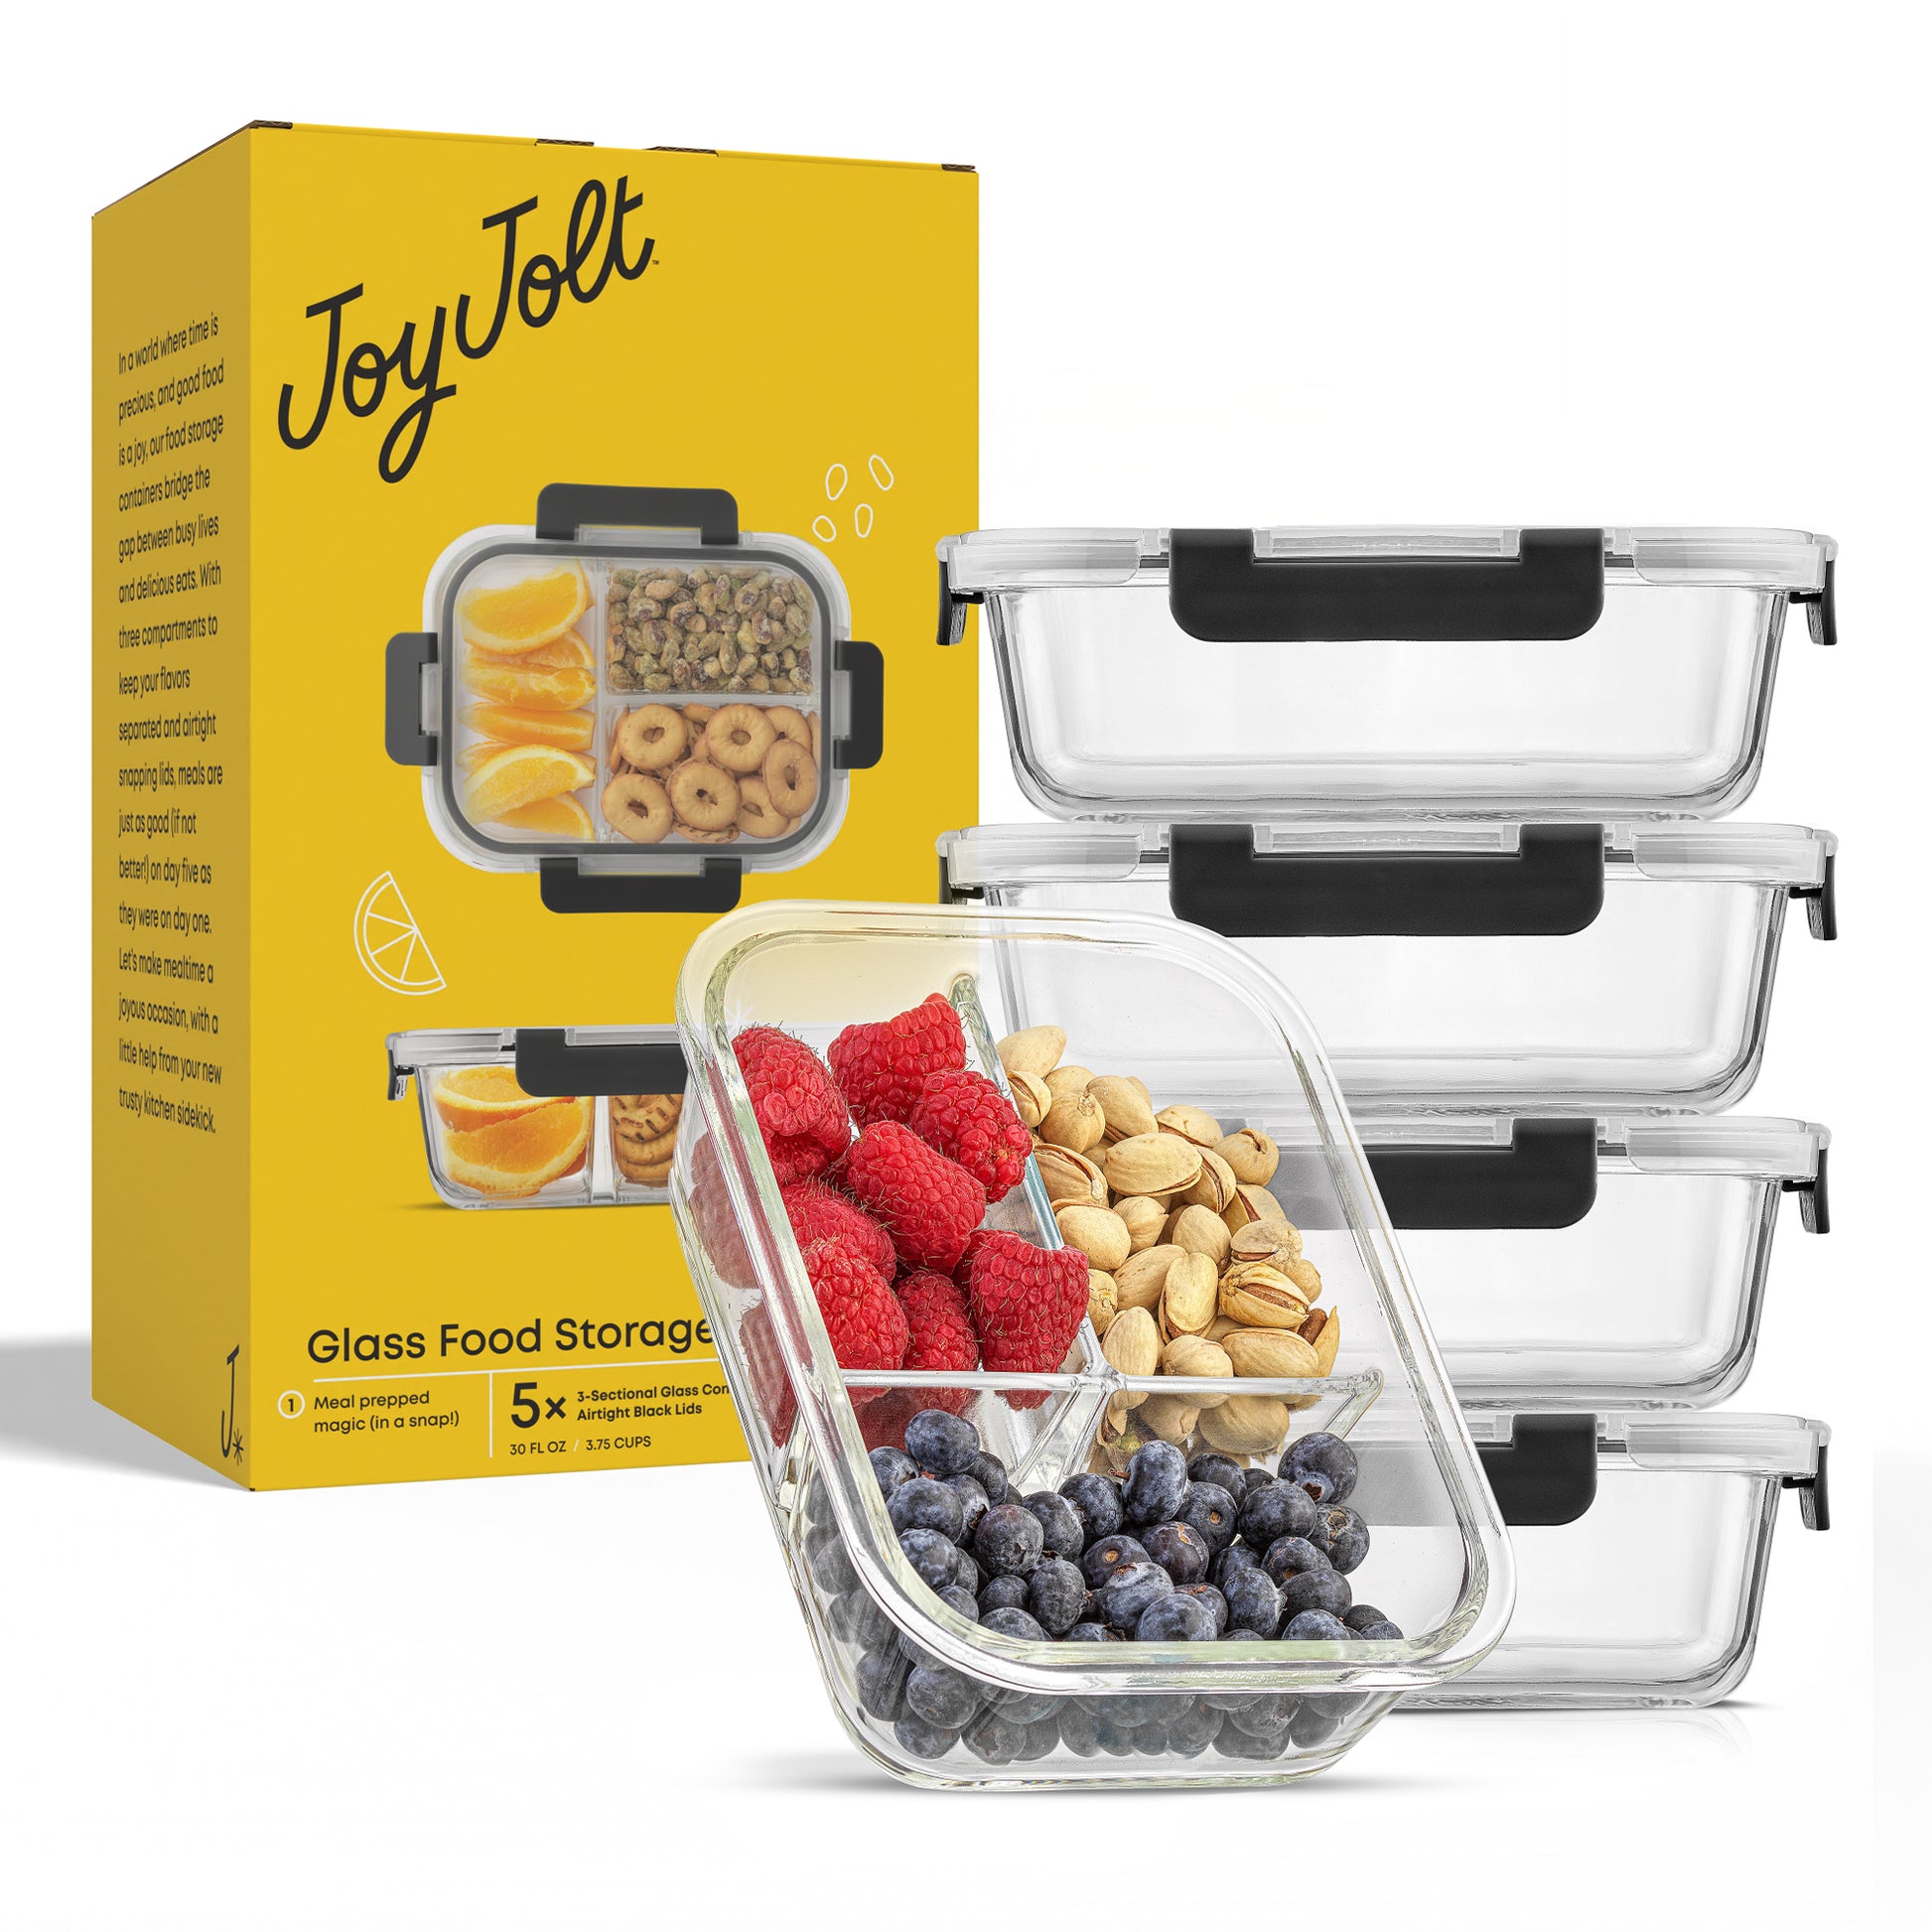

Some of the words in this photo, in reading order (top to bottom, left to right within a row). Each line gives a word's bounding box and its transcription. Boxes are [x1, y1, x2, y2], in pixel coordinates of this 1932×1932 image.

[118, 351, 127, 375] In
[127, 351, 134, 371] a
[134, 335, 159, 368] world
[159, 329, 188, 358] where
[188, 319, 209, 346] time
[210, 311, 219, 338] is
[277, 175, 655, 483] JoyJolt
[118, 389, 157, 427] precious,
[157, 375, 176, 407] and
[176, 366, 201, 406] good
[202, 356, 224, 390] food
[118, 442, 126, 467] is
[126, 445, 133, 465] a
[133, 437, 149, 469] joy,
[149, 434, 165, 457] our
[164, 420, 187, 452] food
[187, 413, 224, 445] storage
[118, 481, 164, 513] containers
[164, 470, 194, 501] bridge
[194, 464, 211, 490] the
[118, 536, 136, 565] gap
[136, 526, 174, 554] between
[175, 519, 198, 548] busy
[198, 512, 219, 539] lives
[118, 577, 136, 605] and
[135, 571, 175, 601] delicious
[175, 568, 199, 594] eats.
[199, 559, 222, 589] With
[118, 624, 141, 649] three
[141, 615, 207, 649] compartments
[207, 613, 218, 636] to
[118, 671, 140, 700] keep
[139, 672, 160, 700] your
[159, 665, 191, 691] flavors
[118, 714, 163, 747] separated
[162, 712, 182, 739] and
[182, 709, 217, 743] airtight
[118, 761, 158, 793] snapping
[158, 760, 177, 789] lids,
[178, 759, 207, 786] meals
[207, 764, 223, 786] are
[118, 809, 135, 838] just
[134, 814, 146, 834] as
[146, 808, 170, 840] good
[170, 806, 181, 836] (if
[181, 811, 198, 835] not
[118, 853, 150, 885] better!)
[150, 861, 162, 882] on
[162, 856, 182, 889] day
[181, 857, 200, 885] five
[200, 864, 212, 886] as
[118, 899, 138, 931] they
[137, 907, 160, 928] were
[159, 909, 172, 930] on
[173, 904, 192, 938] day
[192, 912, 212, 934] one.
[138, 950, 163, 977] make
[163, 954, 206, 983] mealtime
[207, 963, 214, 985] a
[118, 991, 146, 1022] joyous
[146, 1001, 190, 1034] occasion,
[190, 1005, 210, 1034] with
[210, 1014, 219, 1035] a
[118, 1037, 138, 1065] little
[138, 1041, 158, 1075] help
[158, 1045, 180, 1075] from
[180, 1056, 202, 1083] your
[202, 1061, 222, 1085] new
[118, 1086, 144, 1118] trusty
[143, 1089, 176, 1123] kitchen
[177, 1099, 216, 1134] sidekick.
[307, 1326, 426, 1364] Glass
[440, 1317, 541, 1357] Food
[555, 1317, 714, 1354] Storage
[288, 1398, 294, 1413] 1
[314, 1394, 355, 1411] Meal
[359, 1390, 430, 1411] prepped
[576, 1406, 630, 1423] Airtight
[633, 1403, 672, 1418] Black
[675, 1402, 703, 1416] Lids
[577, 1386, 657, 1403] 3-Sectional
[660, 1385, 699, 1398] Glass
[314, 1416, 366, 1435] magic
[369, 1414, 389, 1433] (in
[393, 1417, 405, 1429] a
[408, 1410, 460, 1430] snap!)
[509, 1443, 526, 1455] 30
[530, 1442, 545, 1454] FL
[547, 1440, 567, 1453] OZ
[586, 1438, 611, 1451] 3.75
[614, 1435, 651, 1449] CUPS
